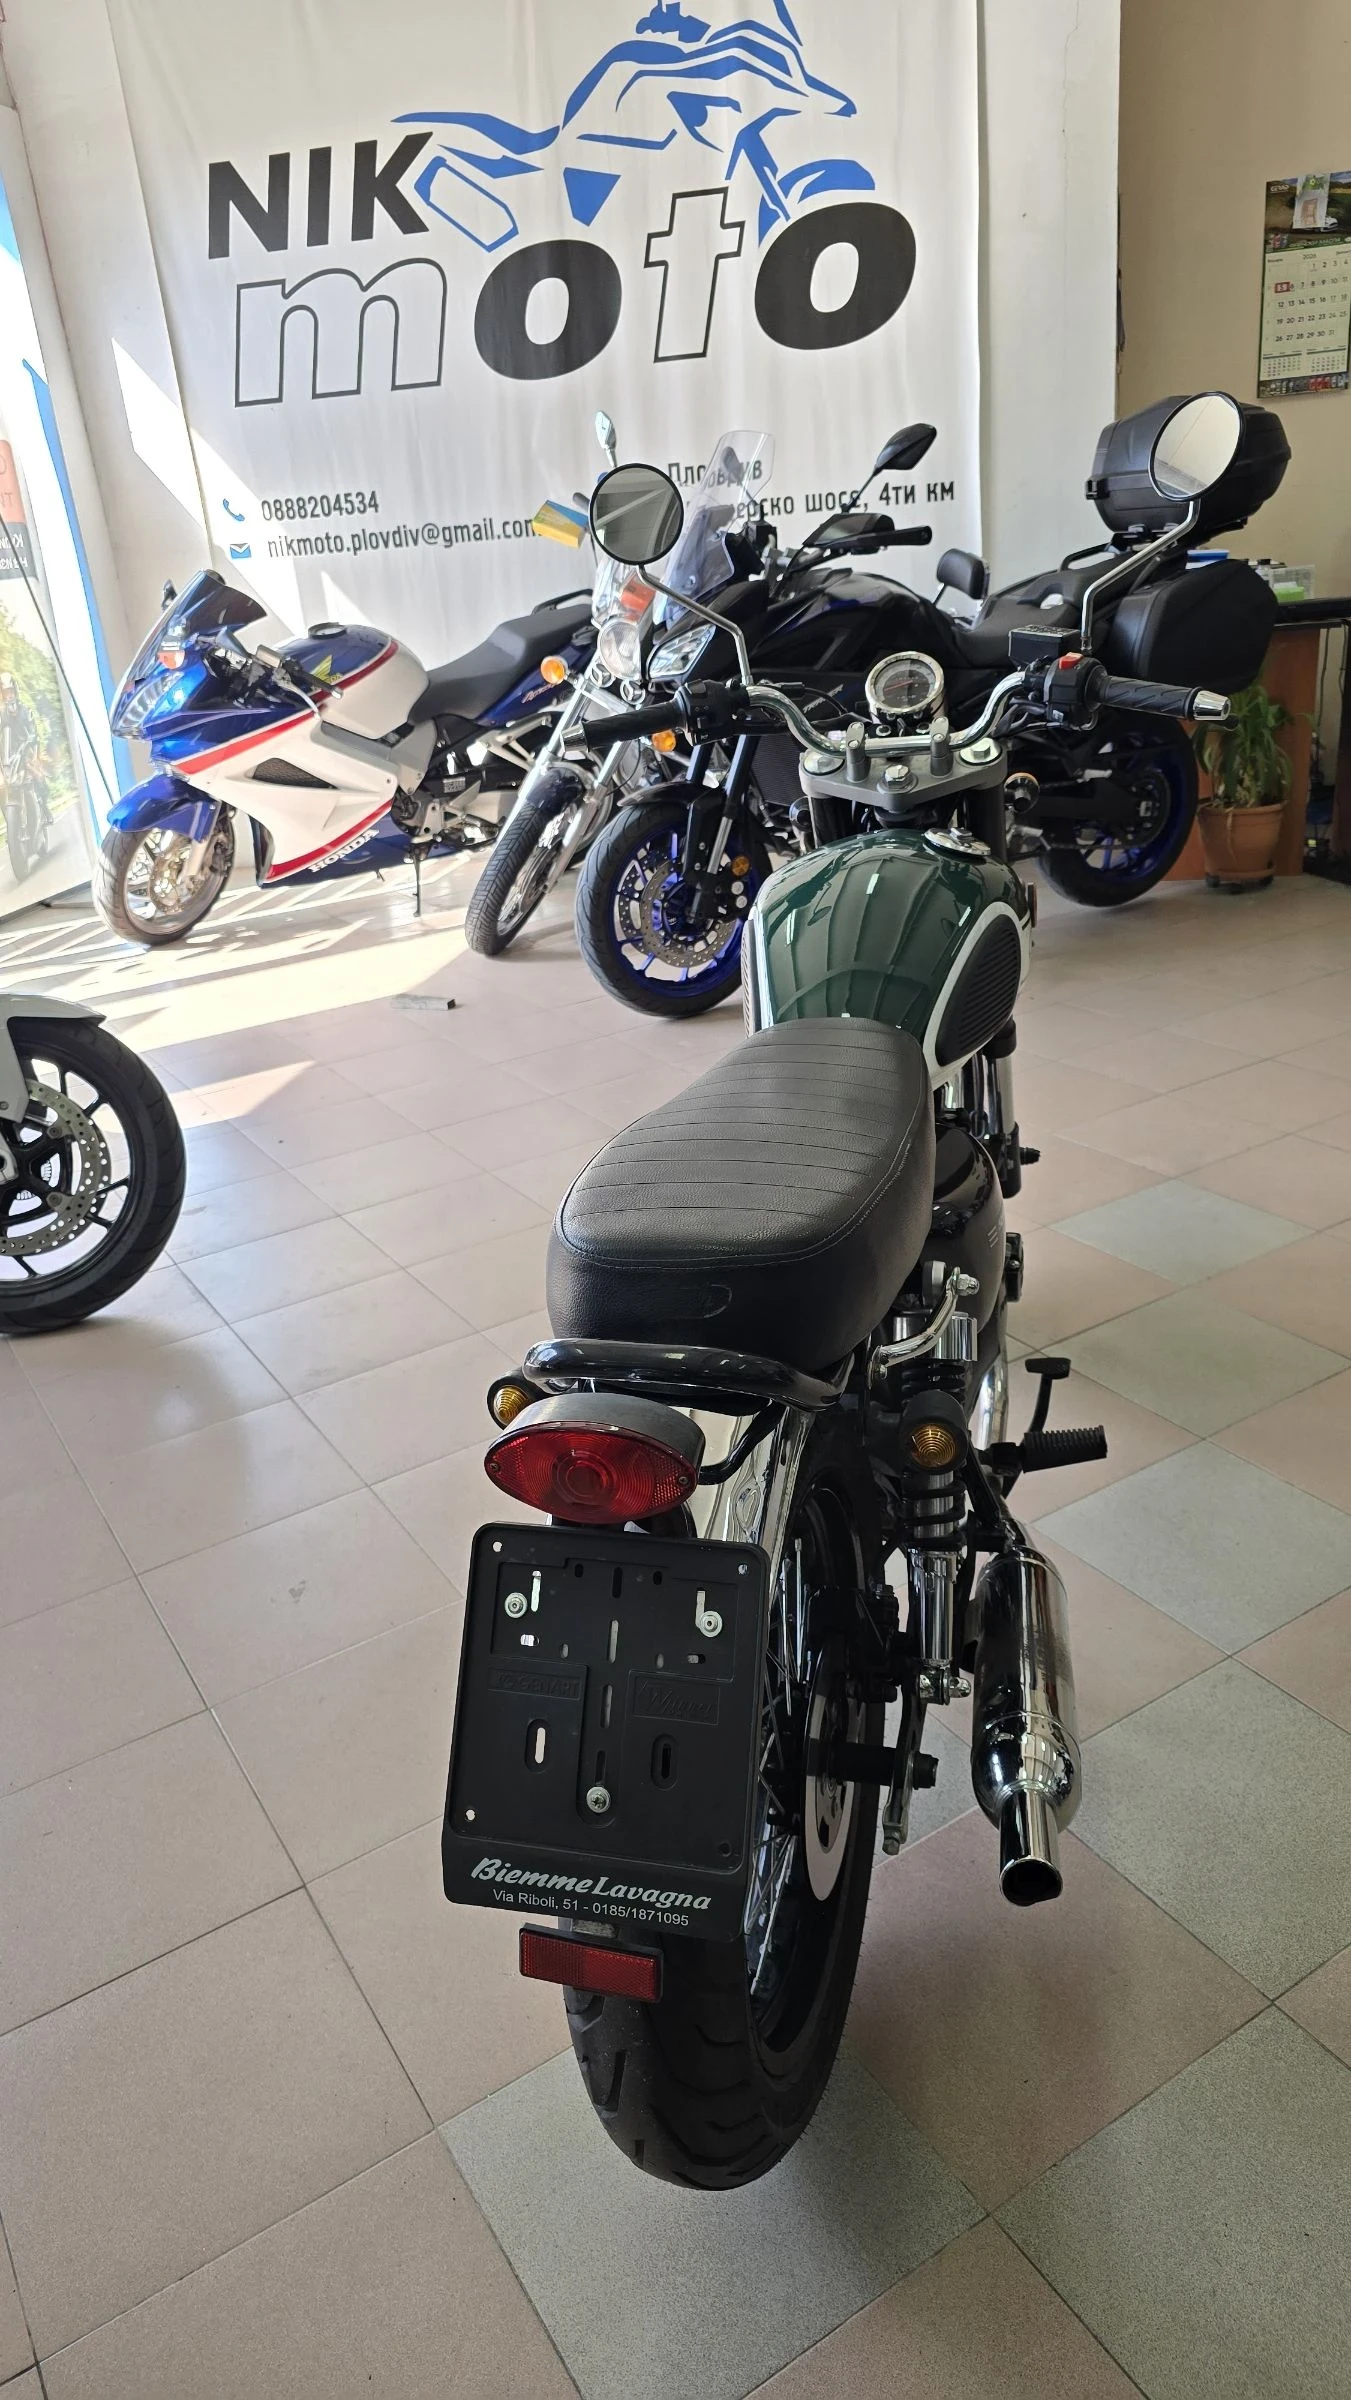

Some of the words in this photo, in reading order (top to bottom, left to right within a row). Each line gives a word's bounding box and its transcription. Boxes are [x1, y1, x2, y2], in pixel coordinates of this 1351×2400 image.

[208, 131, 434, 260] NIK
[234, 186, 917, 408] moto
[261, 490, 380, 522] 0888204534
[879, 482, 915, 505] 4ти
[927, 481, 955, 502] км
[307, 829, 380, 873] HONDA
[492, 1888, 514, 1903] Via
[518, 1892, 559, 1910] Riboli,
[562, 1898, 579, 1911] 51
[592, 1902, 689, 1926] 0185/1871095
